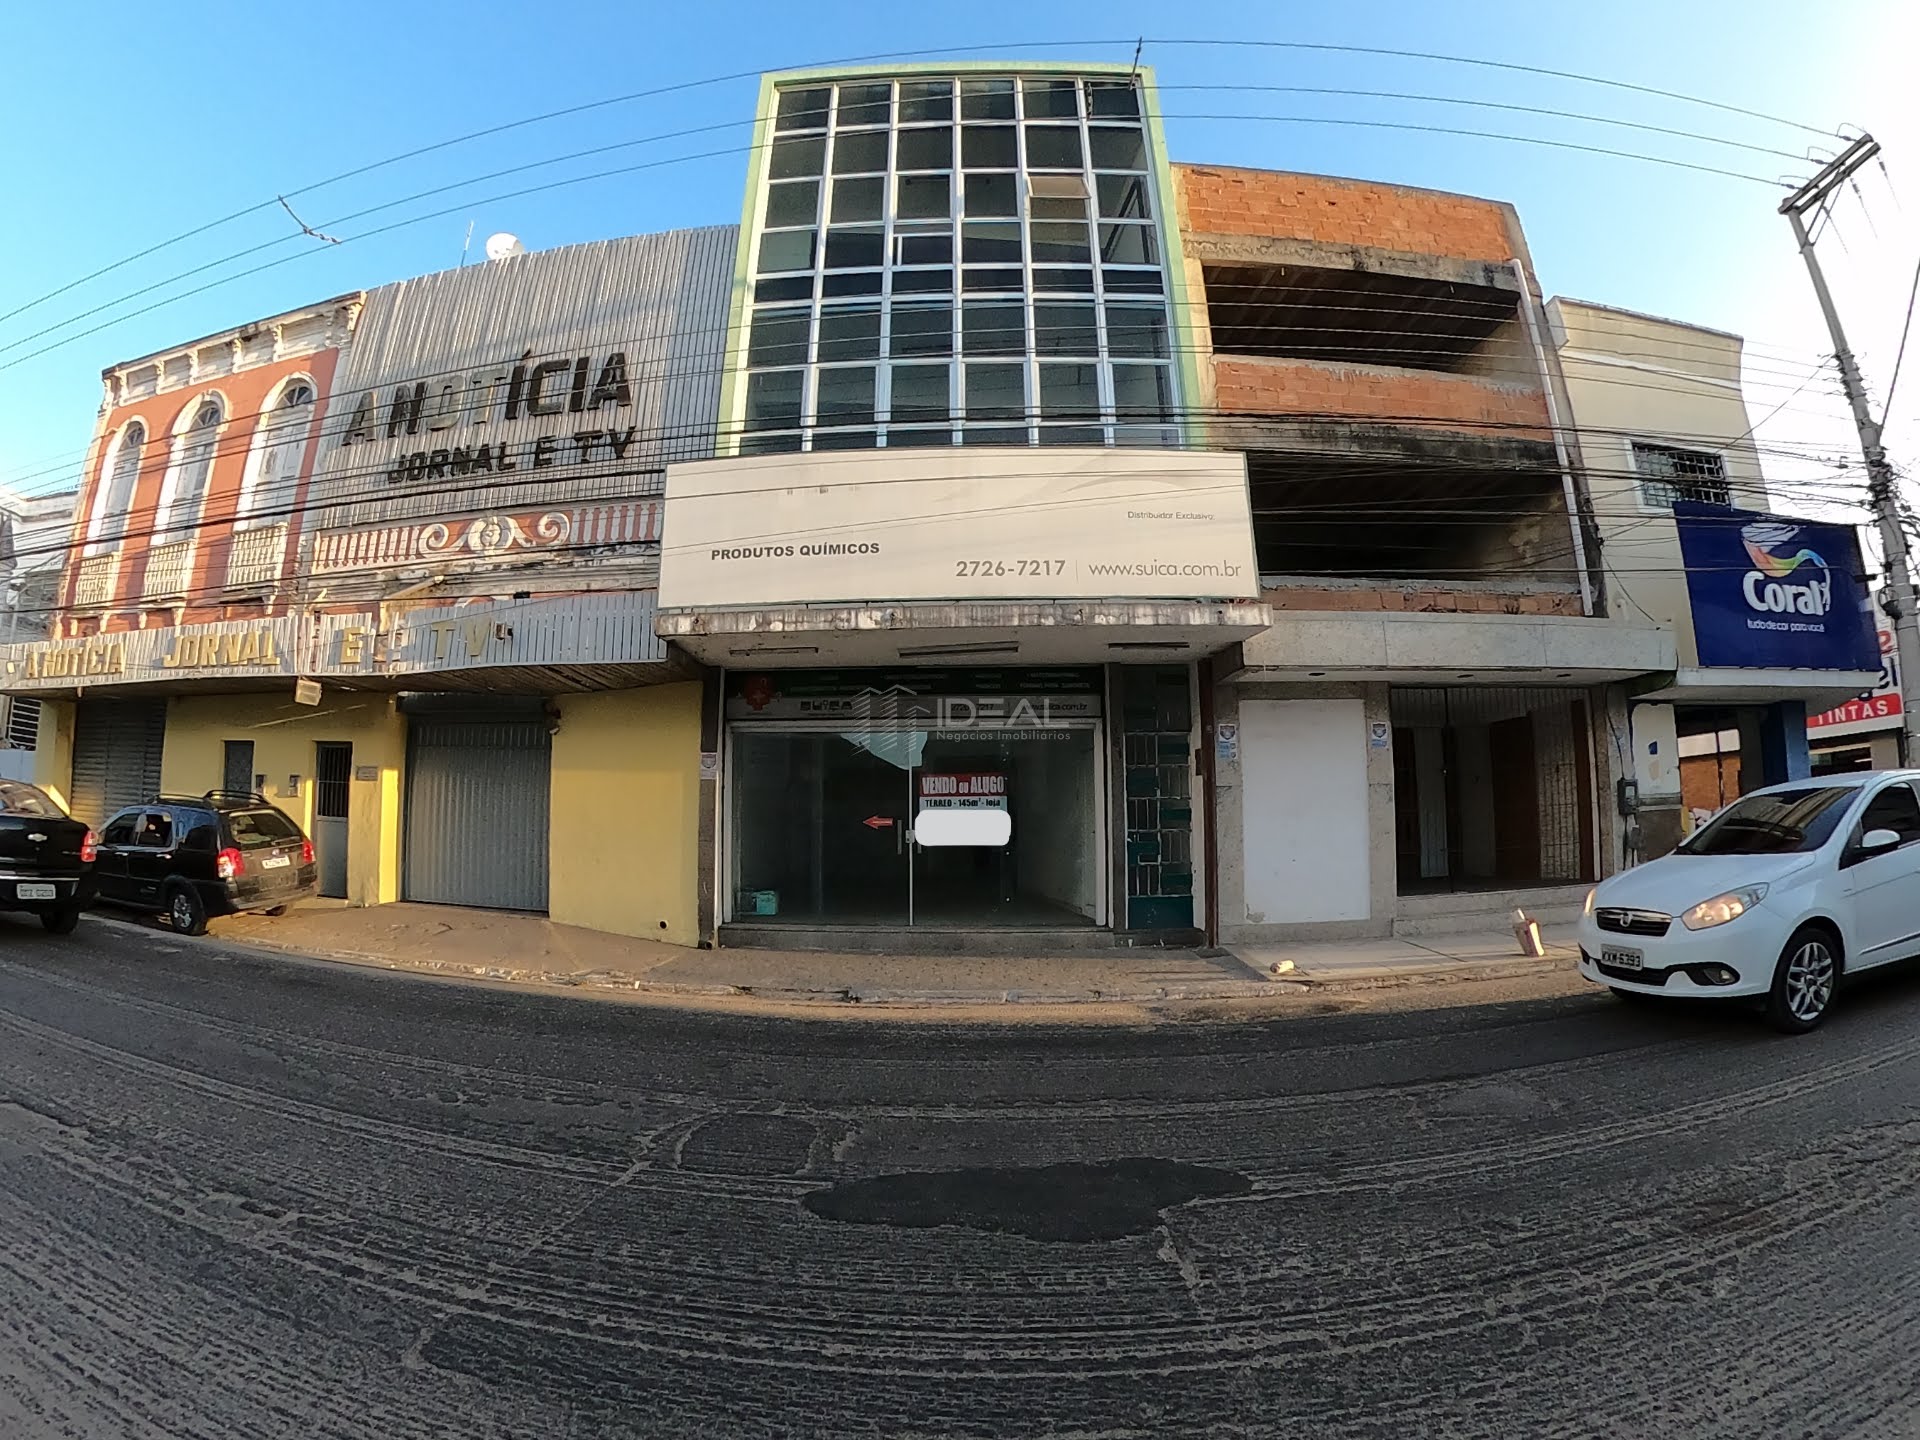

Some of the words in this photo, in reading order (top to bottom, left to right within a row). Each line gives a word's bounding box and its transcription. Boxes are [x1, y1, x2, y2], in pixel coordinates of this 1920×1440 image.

[387, 441, 517, 484] JORNAL
[533, 435, 557, 468] E
[573, 425, 637, 463] TV
[1127, 511, 1174, 519] Distribuidor
[711, 545, 795, 560] PRODUTOS
[799, 542, 881, 557] QUÍMICOS
[955, 560, 1066, 577] 2726-7217
[1088, 558, 1242, 577] www.suica.com.br
[1742, 571, 1825, 616] Coral
[162, 630, 281, 669] JORNAL
[340, 625, 365, 665] E
[430, 614, 492, 660] TV
[922, 776, 957, 794] VENDO
[958, 782, 969, 794] ou
[970, 775, 1005, 795] ALUGO
